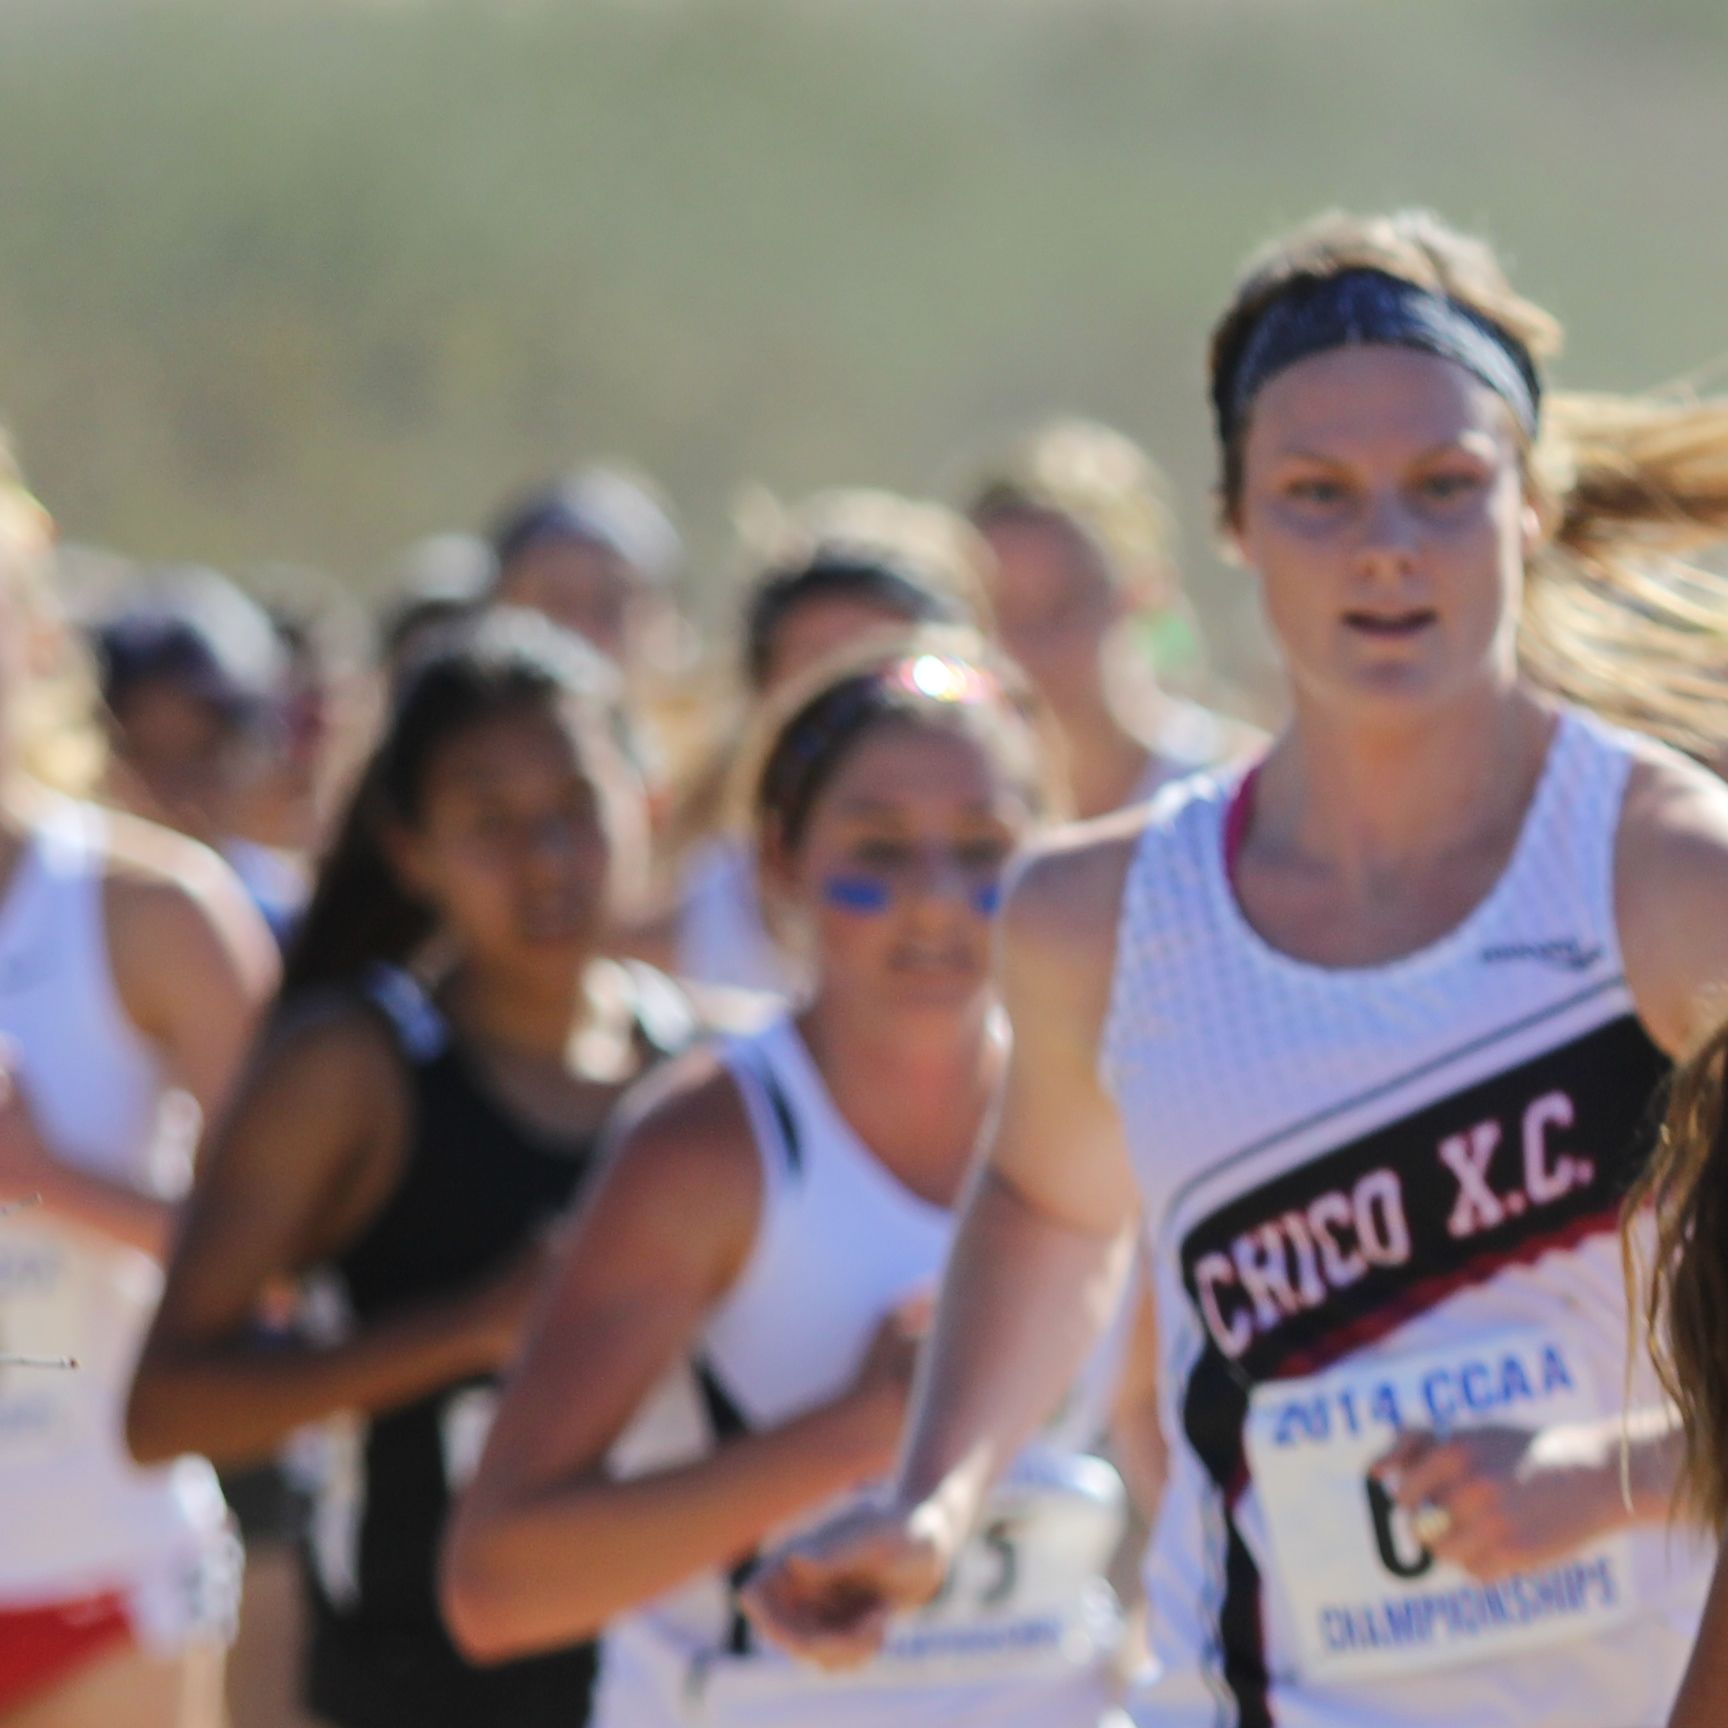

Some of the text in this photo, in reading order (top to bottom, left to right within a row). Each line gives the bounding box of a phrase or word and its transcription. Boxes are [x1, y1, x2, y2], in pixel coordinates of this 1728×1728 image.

[1194, 1089, 1597, 1359] CHICO X.C.
[1273, 1345, 1574, 1447] 2014 CCAA
